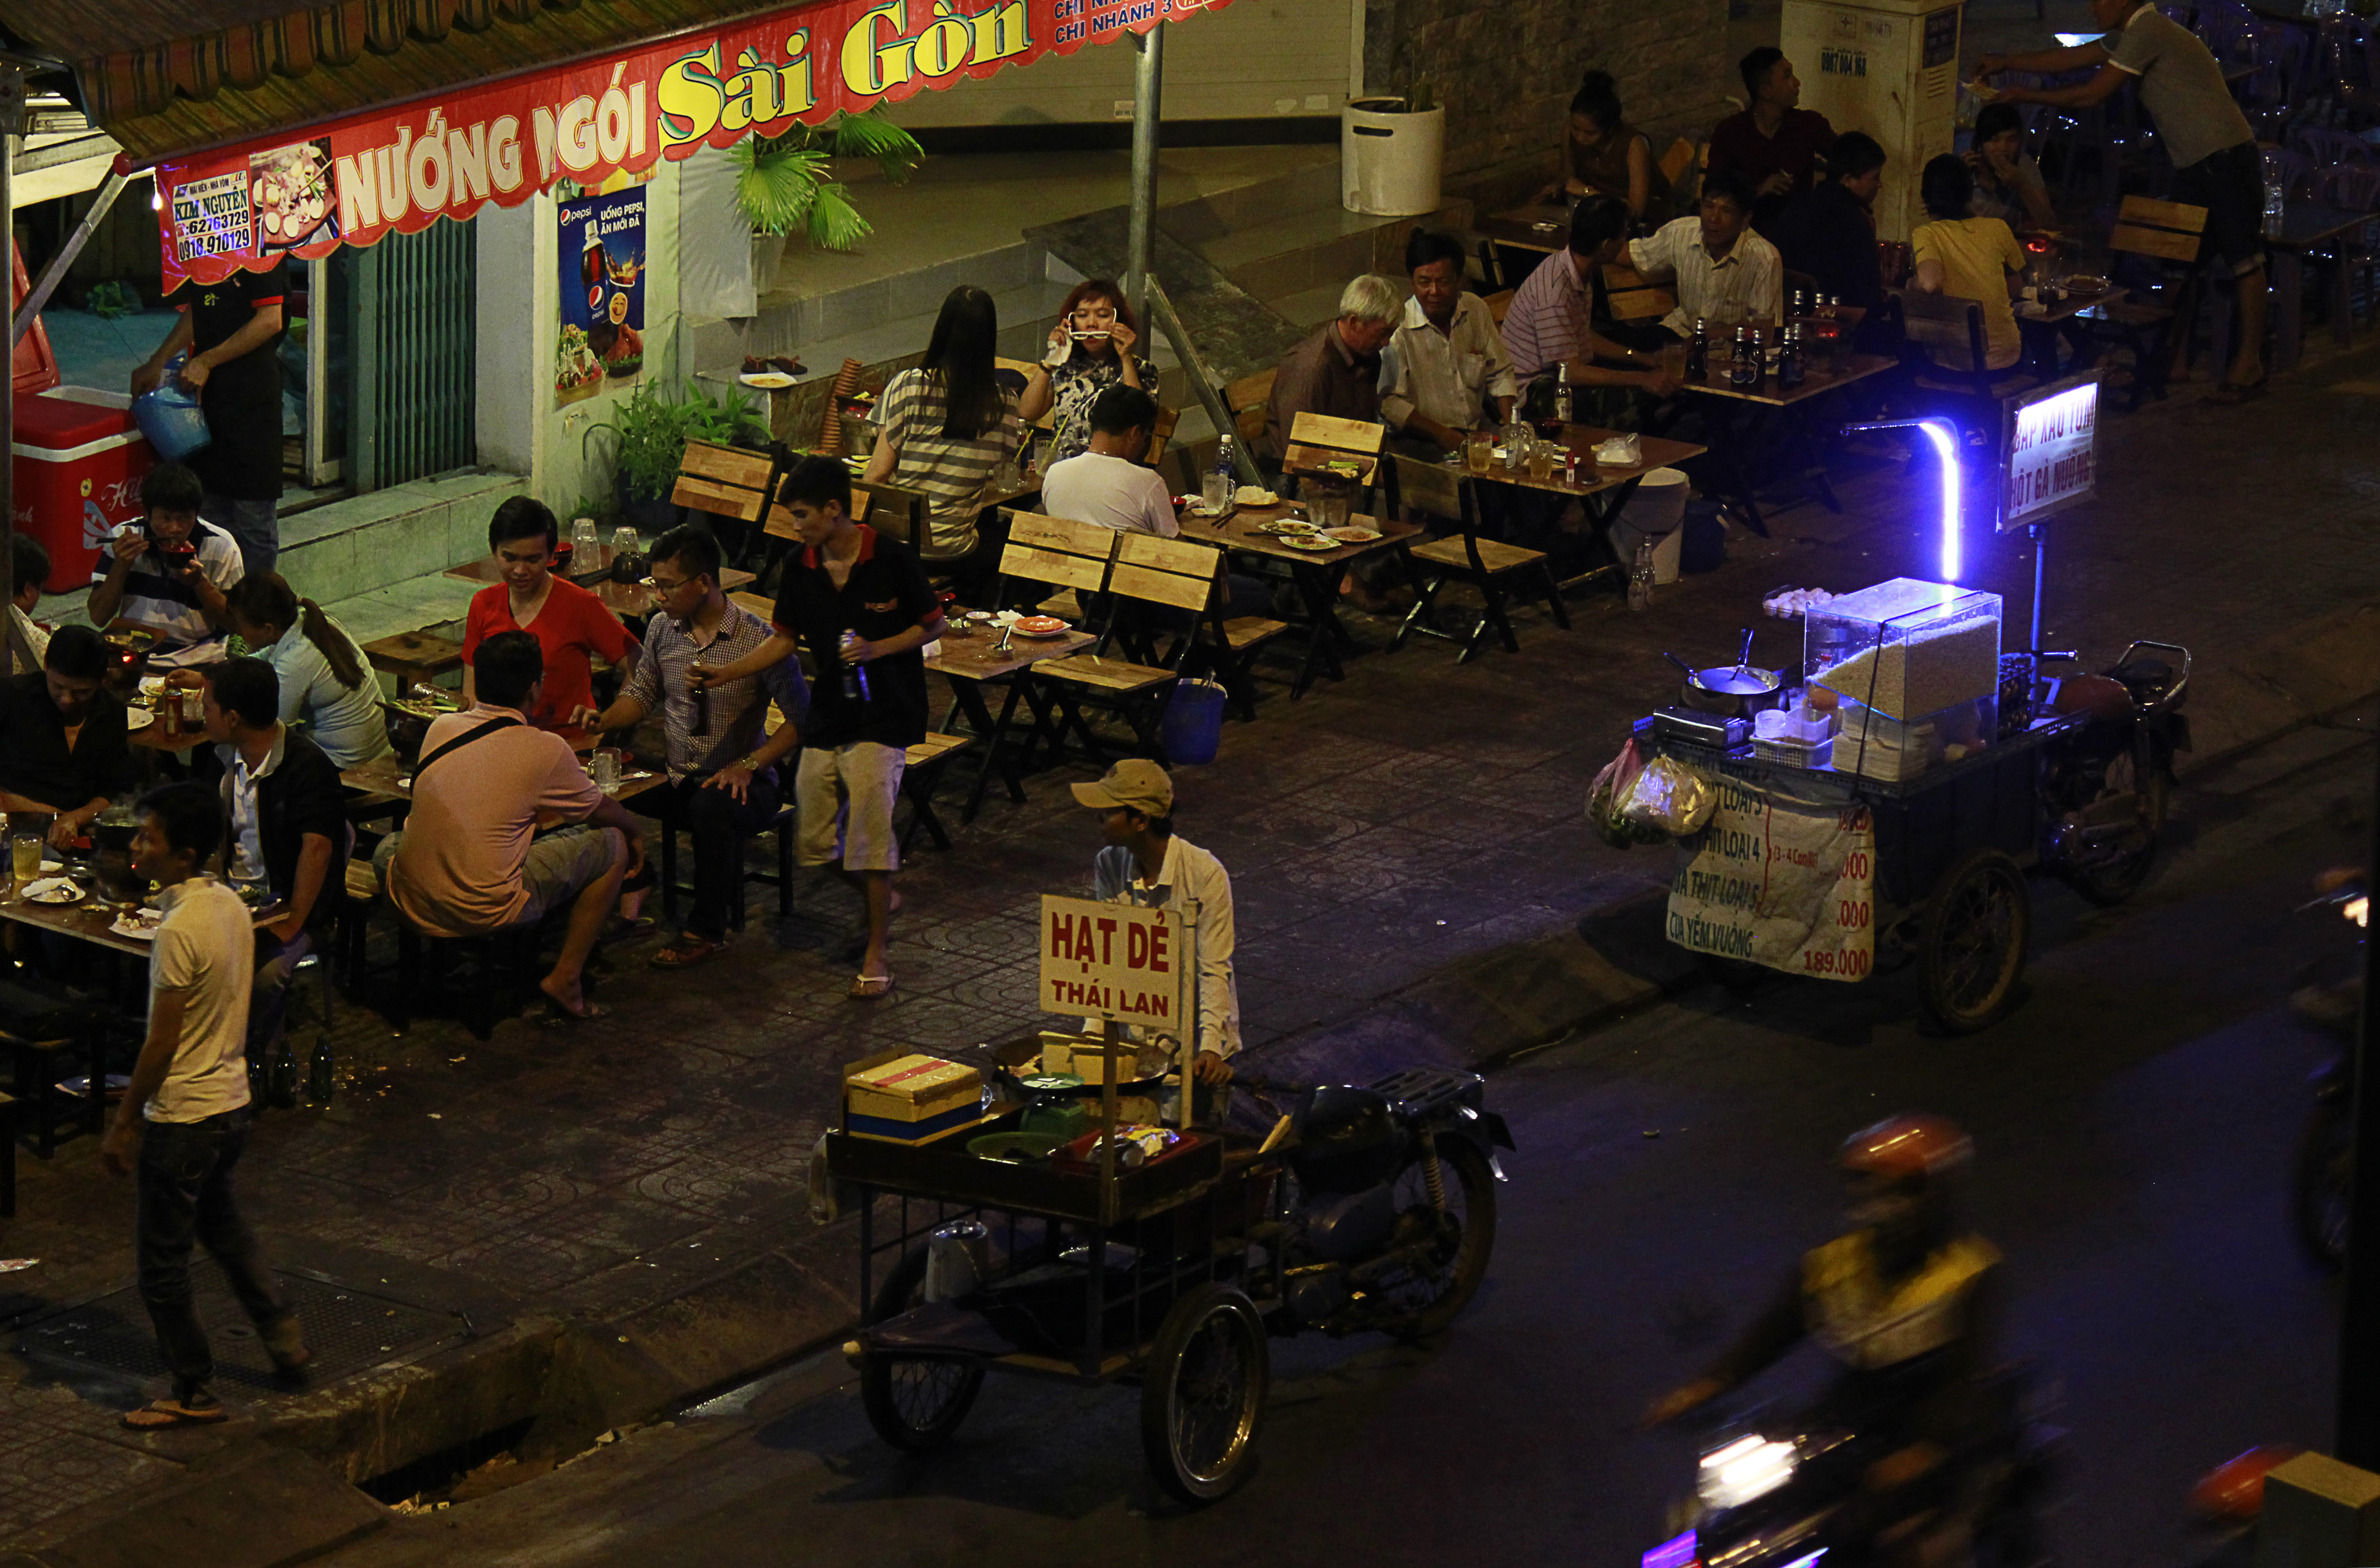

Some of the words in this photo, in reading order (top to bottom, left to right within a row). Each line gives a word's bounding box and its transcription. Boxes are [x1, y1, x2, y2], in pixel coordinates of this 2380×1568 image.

[1055, 20, 1085, 44] CHI
[1092, 1, 1155, 34] NHÁNH
[658, 27, 818, 153] Sài
[840, 0, 1035, 95] Gòn
[336, 106, 524, 235] NƯỚNG
[174, 199, 200, 222] KIM
[571, 206, 591, 222] pepsi
[601, 205, 622, 221] UỐNG
[179, 228, 249, 261] 0918.910129
[601, 223, 611, 235] ĂN
[1724, 829, 1750, 867] LOẠI
[1752, 837, 1760, 862] 4
[1052, 911, 1117, 973] HẠT
[1128, 911, 1169, 973] DẺ
[1804, 948, 1868, 976] 189.000
[1051, 978, 1111, 1008] THÁI
[1120, 989, 1168, 1017] LAN
